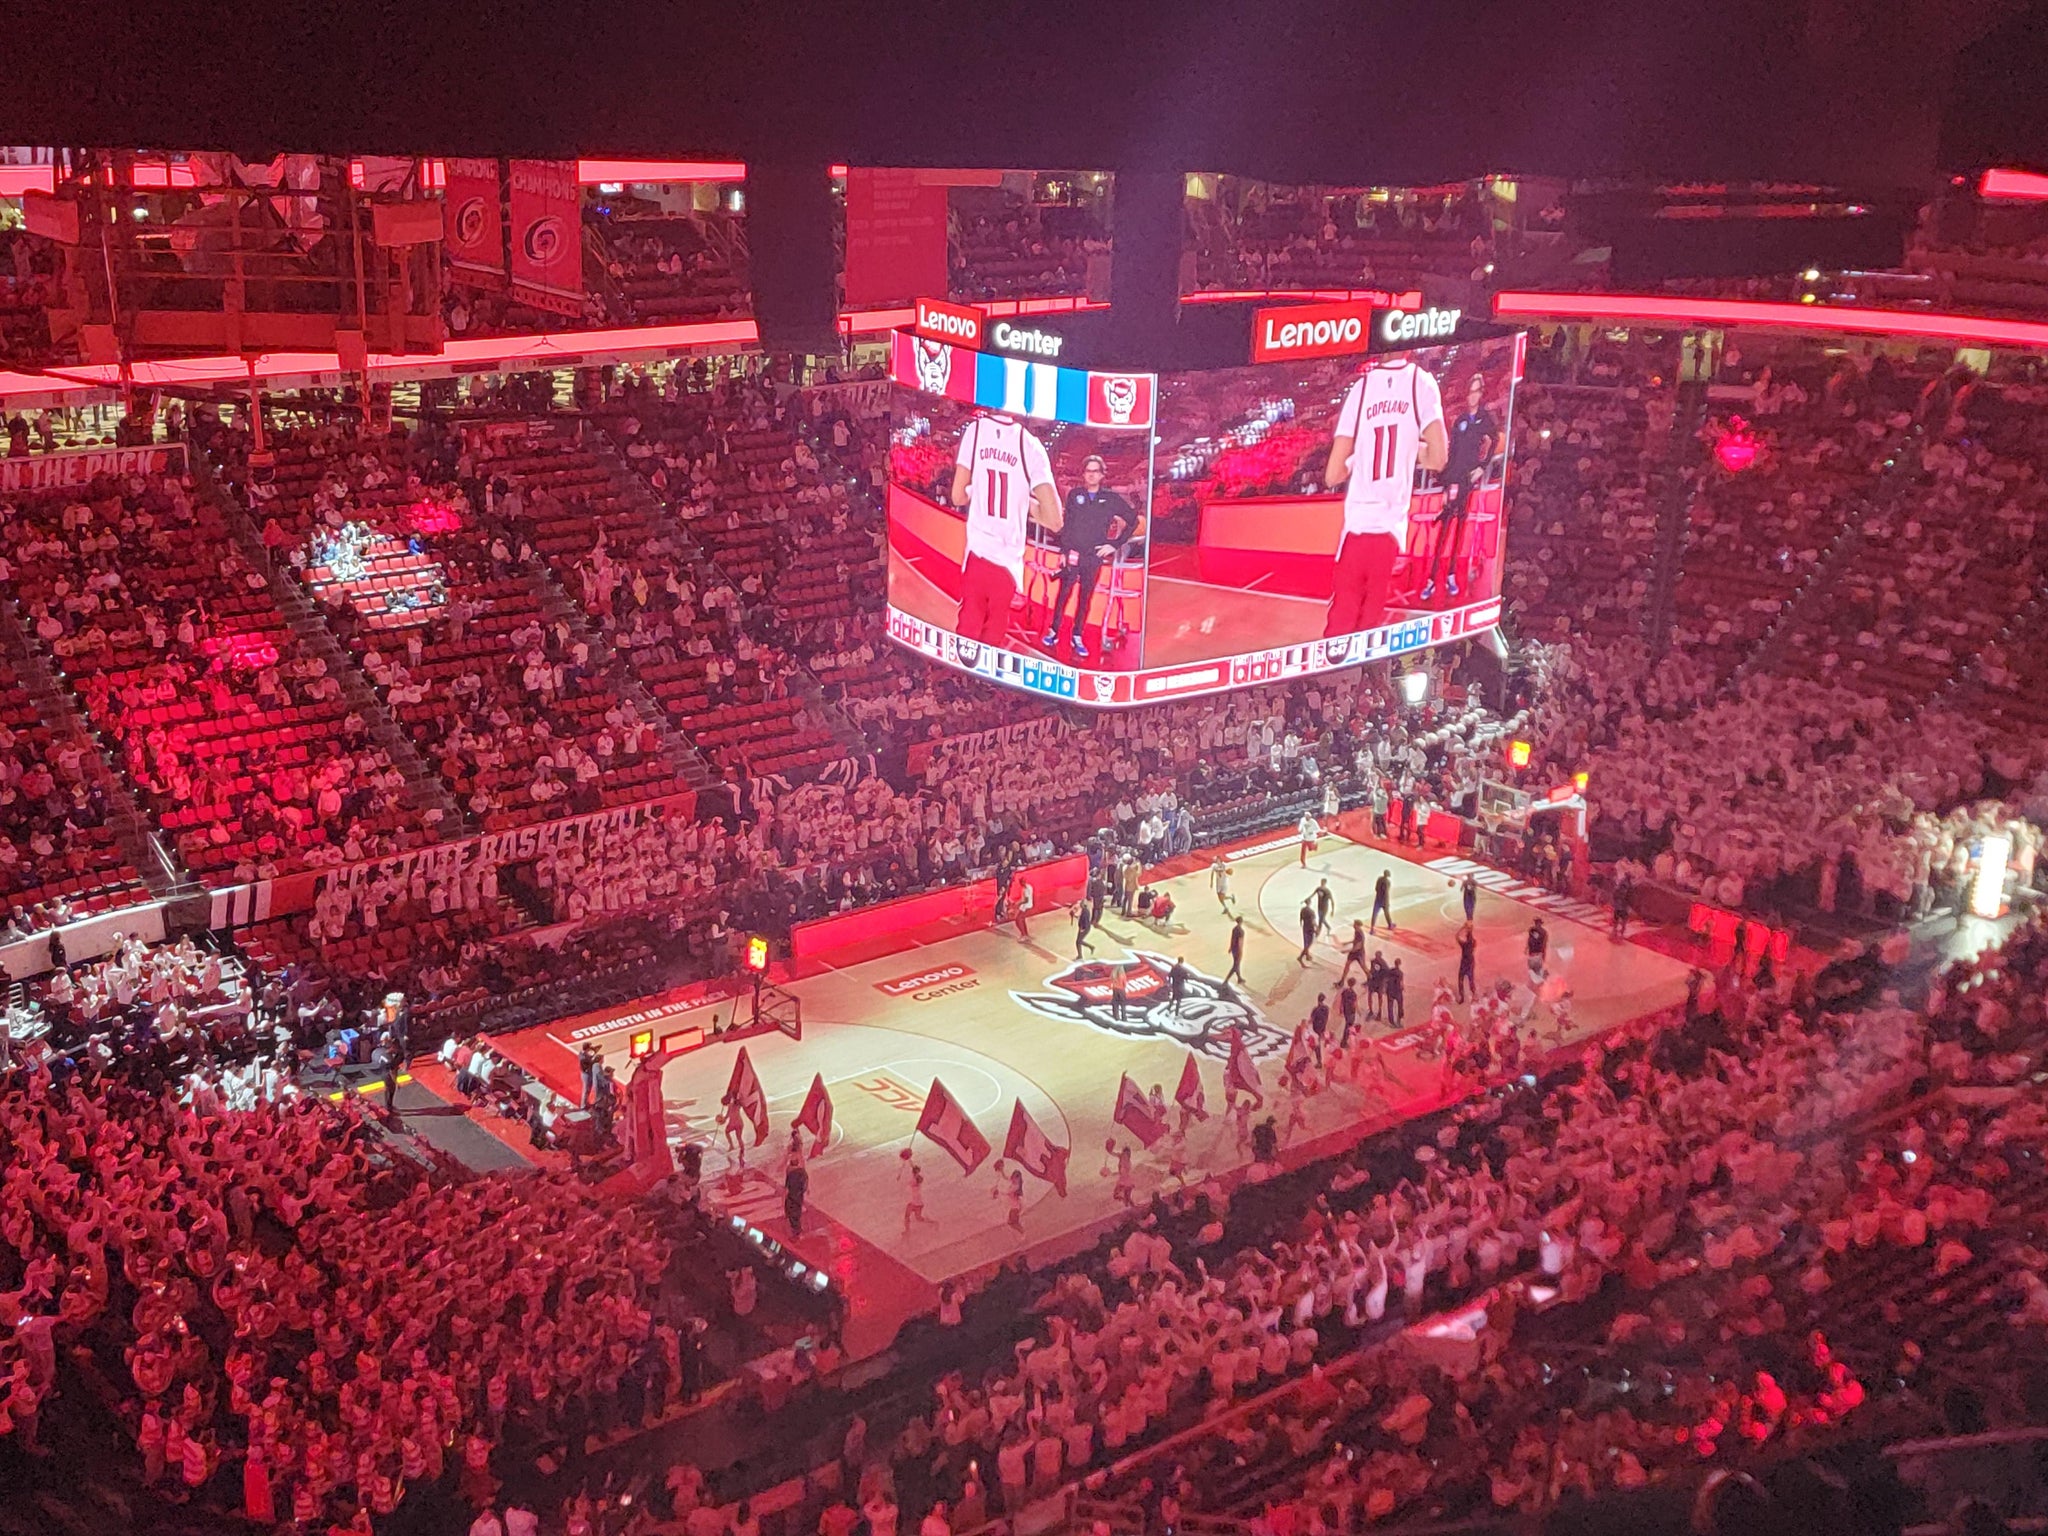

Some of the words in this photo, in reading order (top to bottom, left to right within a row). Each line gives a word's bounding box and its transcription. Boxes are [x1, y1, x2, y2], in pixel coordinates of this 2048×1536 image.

[920, 304, 977, 339] Lenovo
[994, 322, 1063, 356] Center
[1265, 317, 1361, 349] Lenovo
[1383, 307, 1461, 341] Center
[1366, 400, 1410, 421] COPELAND
[979, 447, 1018, 467] COPELAND
[1372, 423, 1398, 482] 11
[0, 462, 22, 493] N
[29, 457, 81, 490] THE
[986, 468, 1008, 519] 11
[883, 966, 964, 993] Lenovo
[912, 978, 981, 1002] Center
[571, 1012, 646, 1039] STRENGTH
[643, 1007, 664, 1019] IN
[661, 1000, 692, 1014] THE
